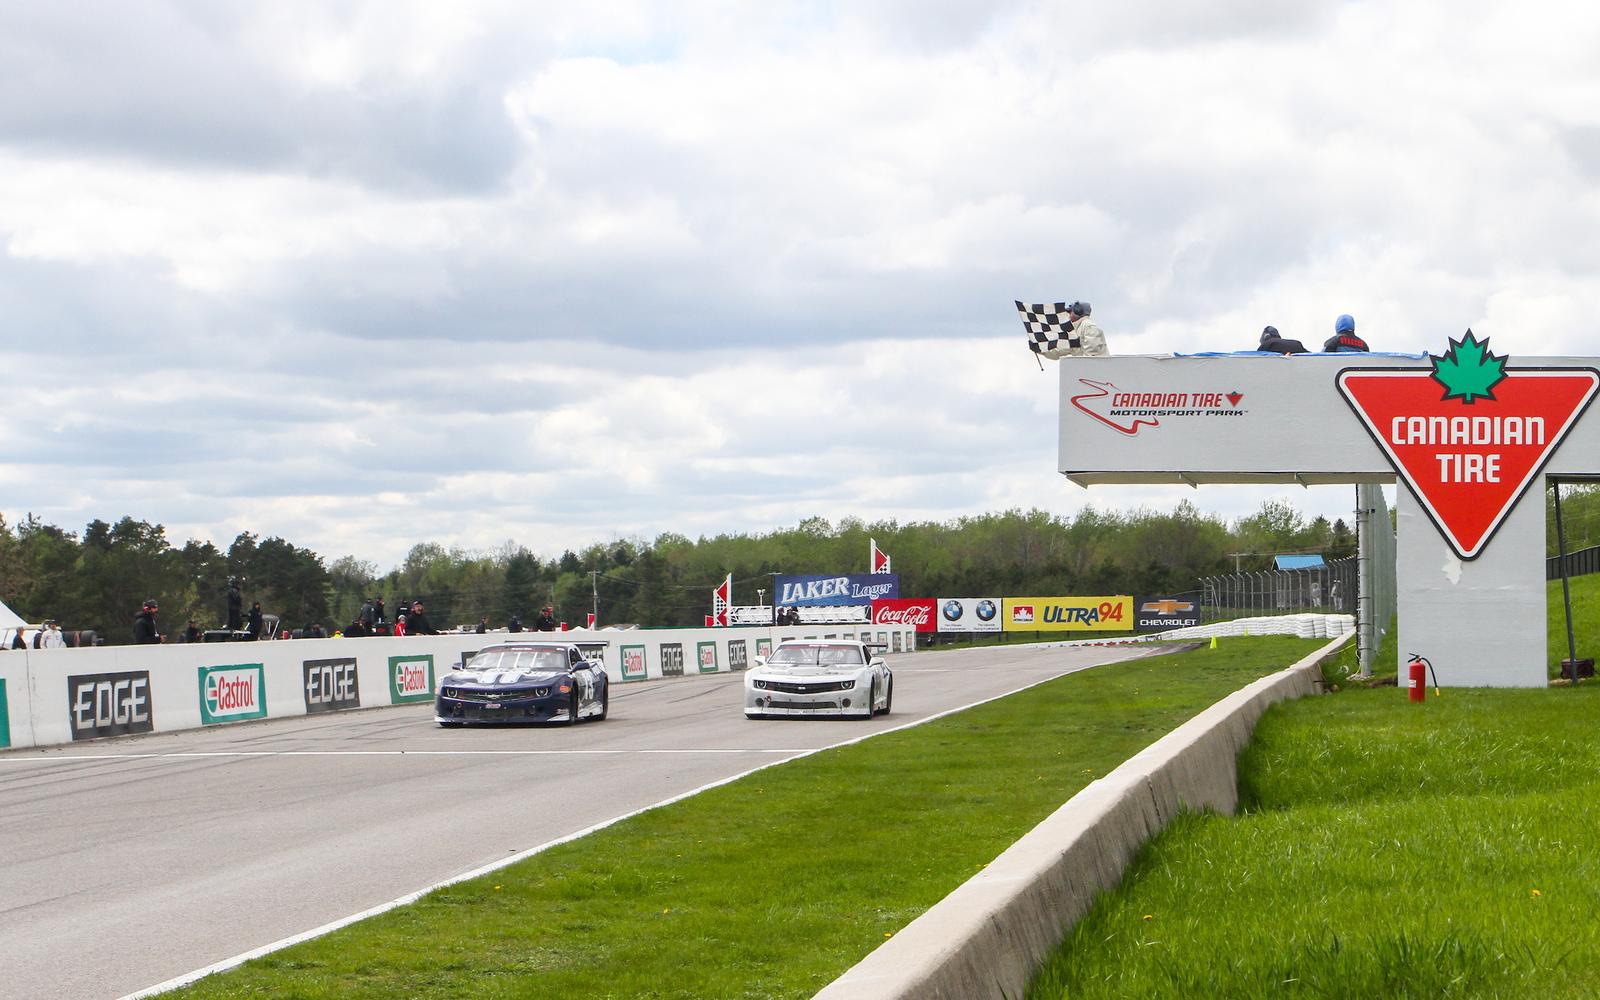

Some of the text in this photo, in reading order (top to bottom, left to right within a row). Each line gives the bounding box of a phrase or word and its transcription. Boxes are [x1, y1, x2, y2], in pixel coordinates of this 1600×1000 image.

[1112, 393, 1223, 408] CANADIAN TIRE
[1391, 416, 1545, 445] CANADIAN
[1435, 453, 1501, 483] TIRE
[781, 576, 892, 604] LAKER Lager
[662, 647, 683, 671] EDGE
[218, 675, 253, 710] Castrol
[306, 664, 357, 704] EDGE
[403, 665, 426, 692] Castrol
[73, 677, 149, 730] EDGE
